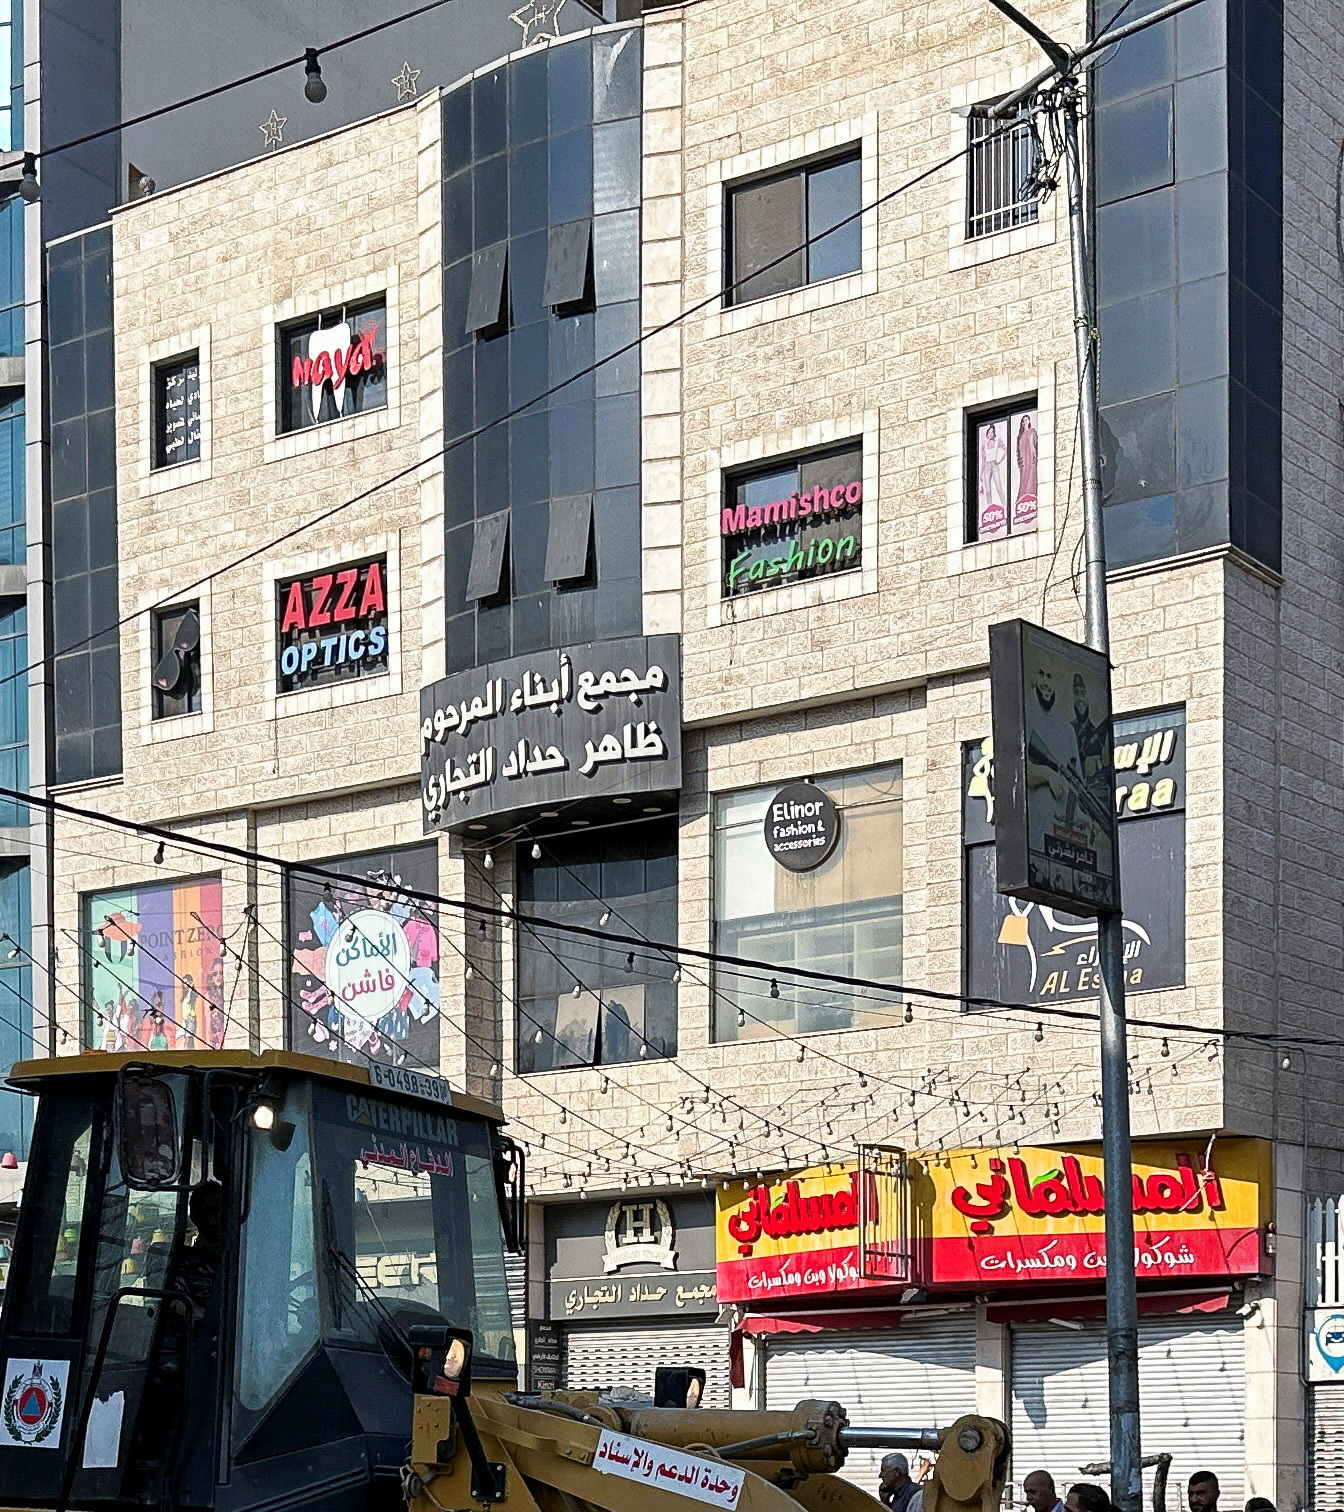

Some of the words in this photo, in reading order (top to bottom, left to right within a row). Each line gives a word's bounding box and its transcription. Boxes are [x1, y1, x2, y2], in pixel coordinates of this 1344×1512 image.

[722, 481, 862, 534] Mamishco
[729, 535, 854, 588] Fashion
[281, 563, 384, 633] AZZA
[281, 625, 386, 675] OPTICS
[511, 653, 570, 713] أبناء
[577, 665, 665, 711] مجمع
[421, 678, 502, 753] المرحوم
[502, 738, 566, 778] حداد
[578, 721, 663, 774] ظاهر
[423, 746, 494, 821] التجاري
[772, 801, 824, 822] Elinor
[774, 834, 825, 852] accessories
[140, 929, 184, 948] POINT
[341, 968, 396, 1001] فاشن
[1039, 970, 1070, 996] AL
[346, 1094, 459, 1147] CATERPILLAR
[980, 1240, 1077, 1272] ومكسرات
[565, 1283, 622, 1315] التجاري
[628, 1283, 668, 1302] حداد
[675, 1284, 717, 1308] مجمع
[599, 1439, 654, 1477] والإسناد
[655, 1462, 700, 1485] الدعم
[700, 1468, 739, 1503] وحدة
